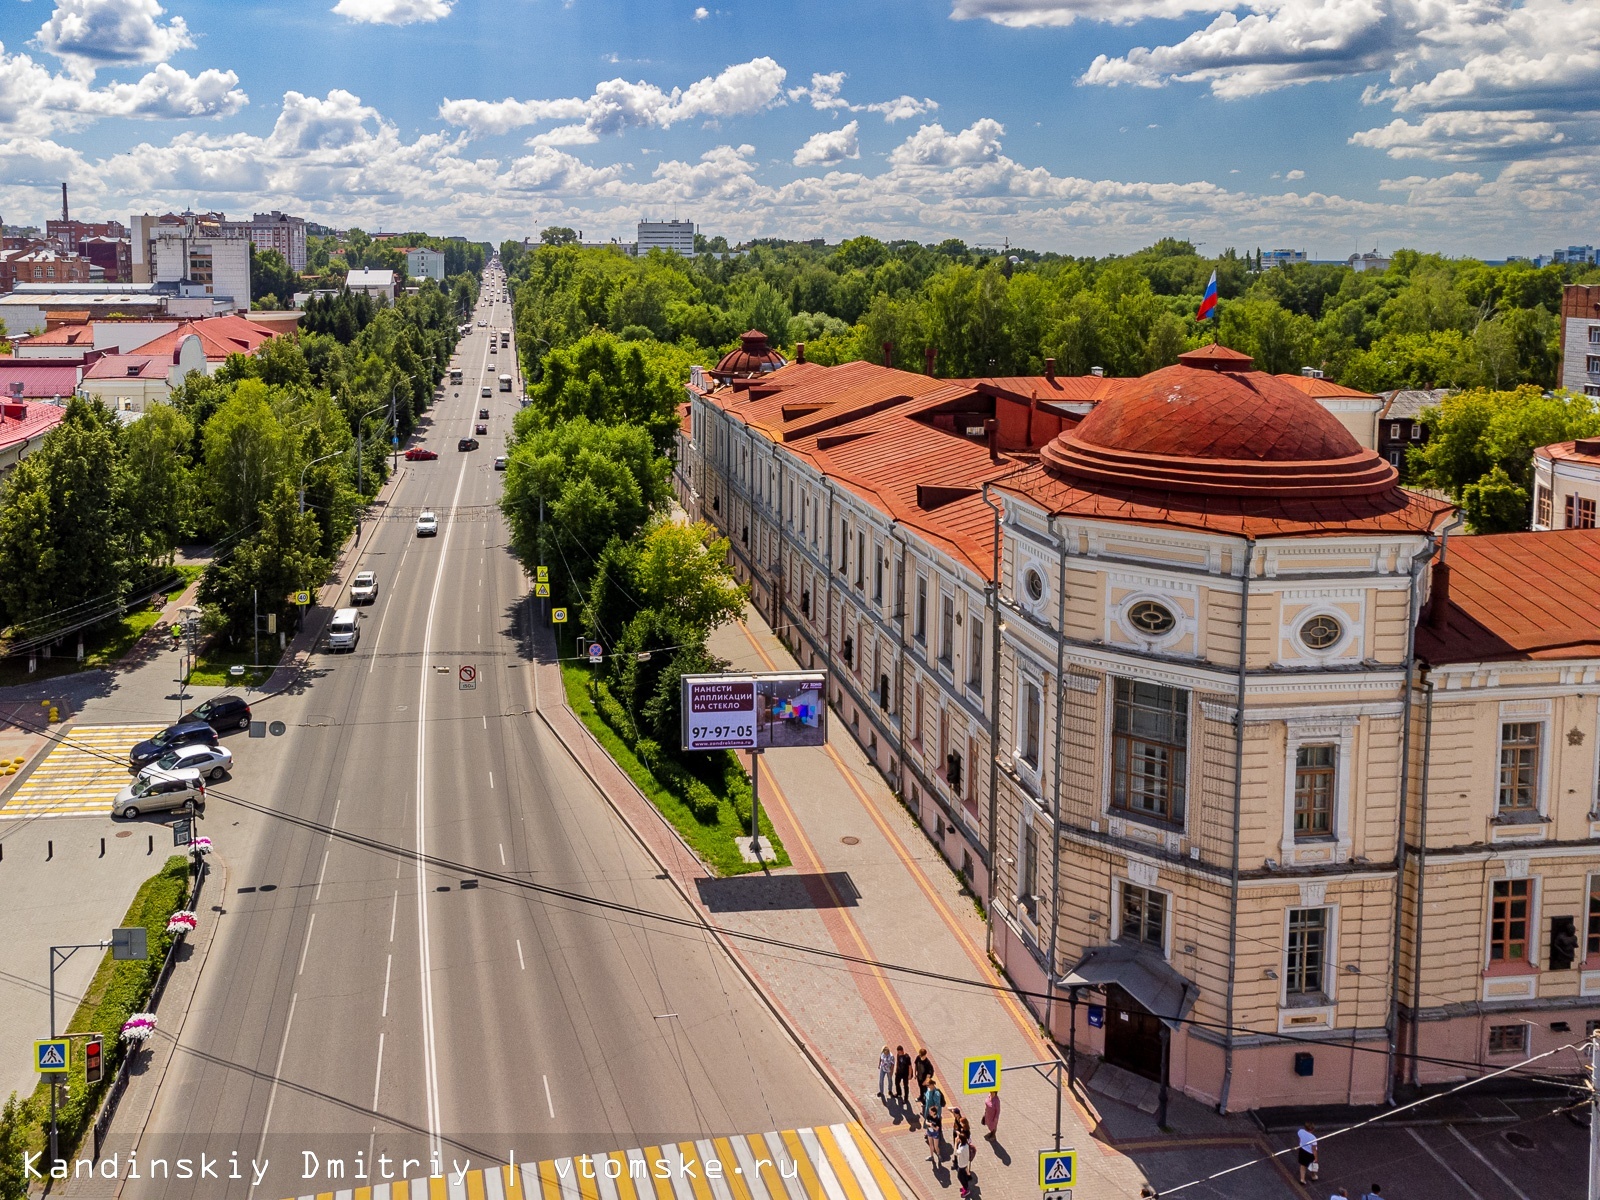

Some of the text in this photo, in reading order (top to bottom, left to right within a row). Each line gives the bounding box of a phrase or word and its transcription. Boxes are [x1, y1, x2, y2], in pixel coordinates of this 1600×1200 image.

[694, 685, 732, 693] НАНЕСТИ
[694, 693, 752, 702] АППЛИКАЦИИ
[692, 726, 752, 738] 97-97-05
